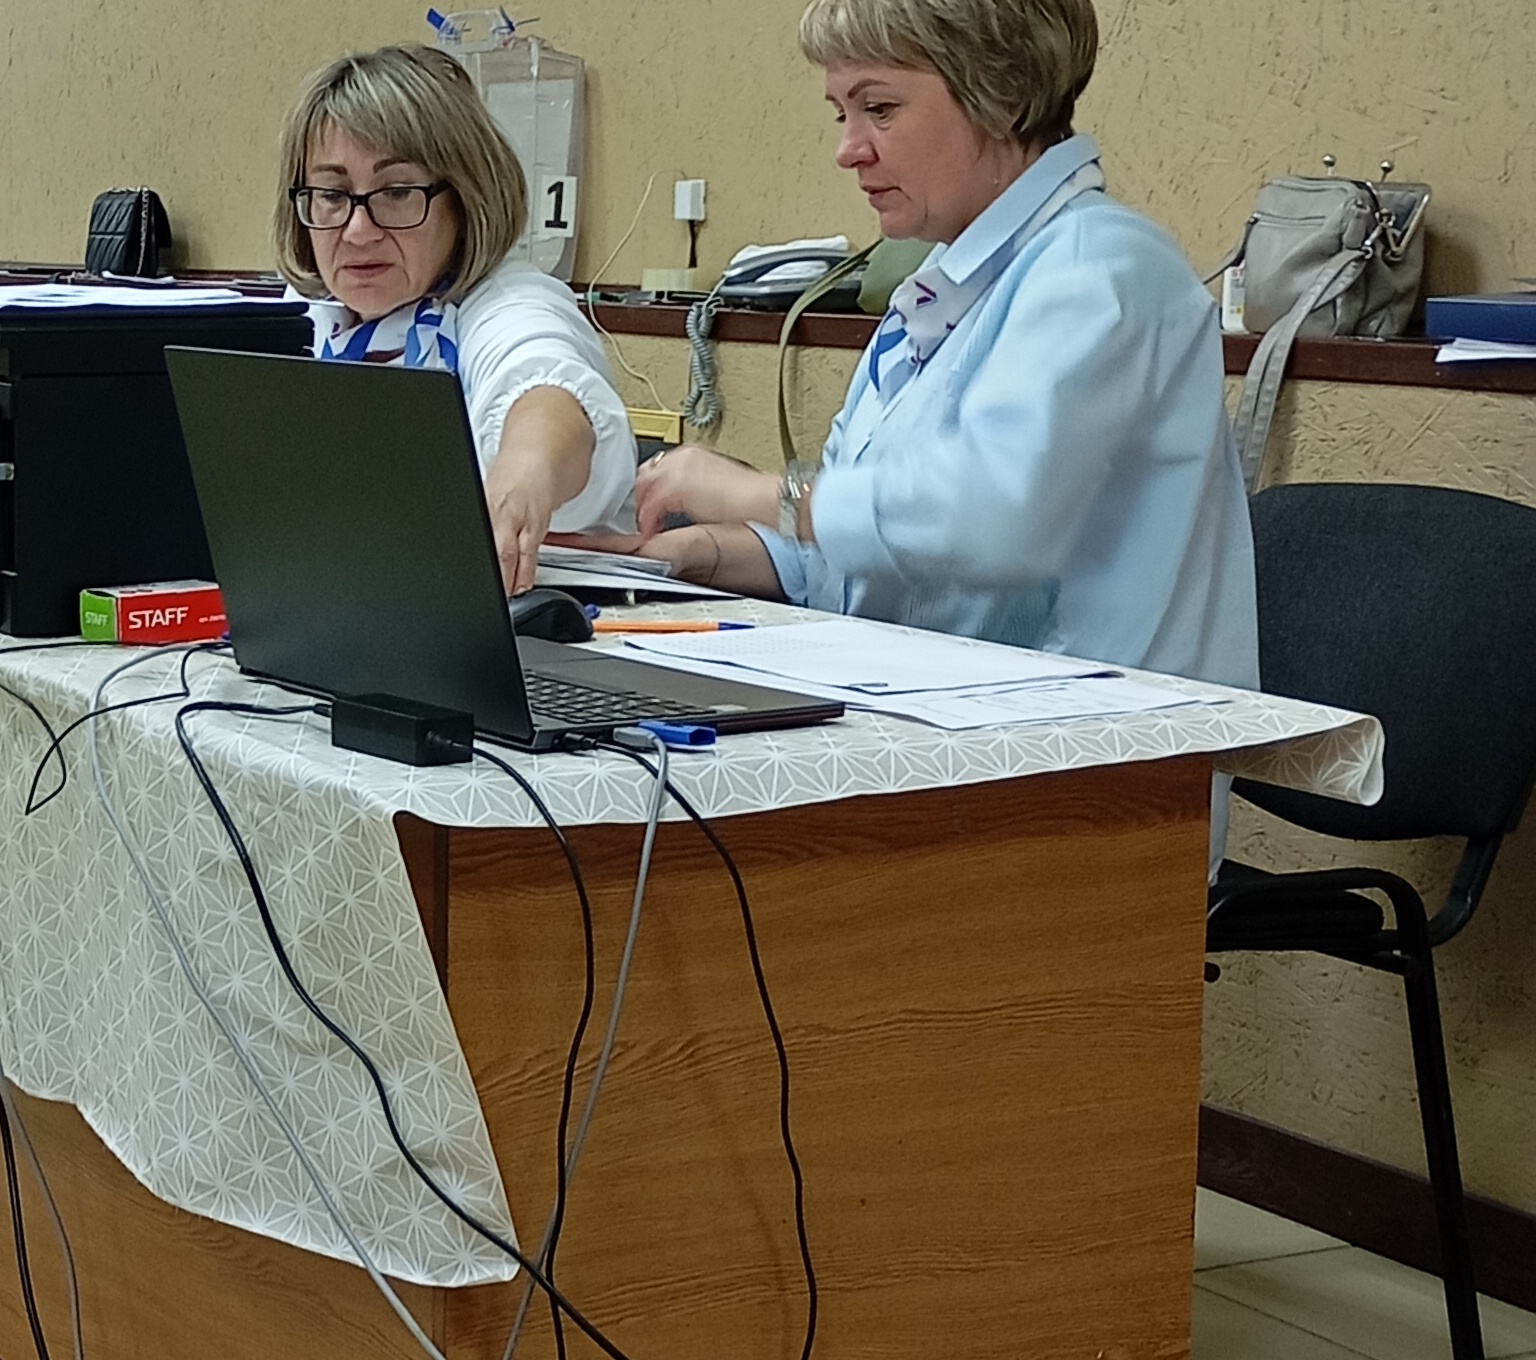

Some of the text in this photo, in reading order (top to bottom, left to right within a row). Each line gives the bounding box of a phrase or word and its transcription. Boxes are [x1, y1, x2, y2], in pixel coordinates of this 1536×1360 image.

[544, 180, 568, 230] 1
[84, 611, 109, 627] STAFF
[128, 606, 189, 630] STAFF
